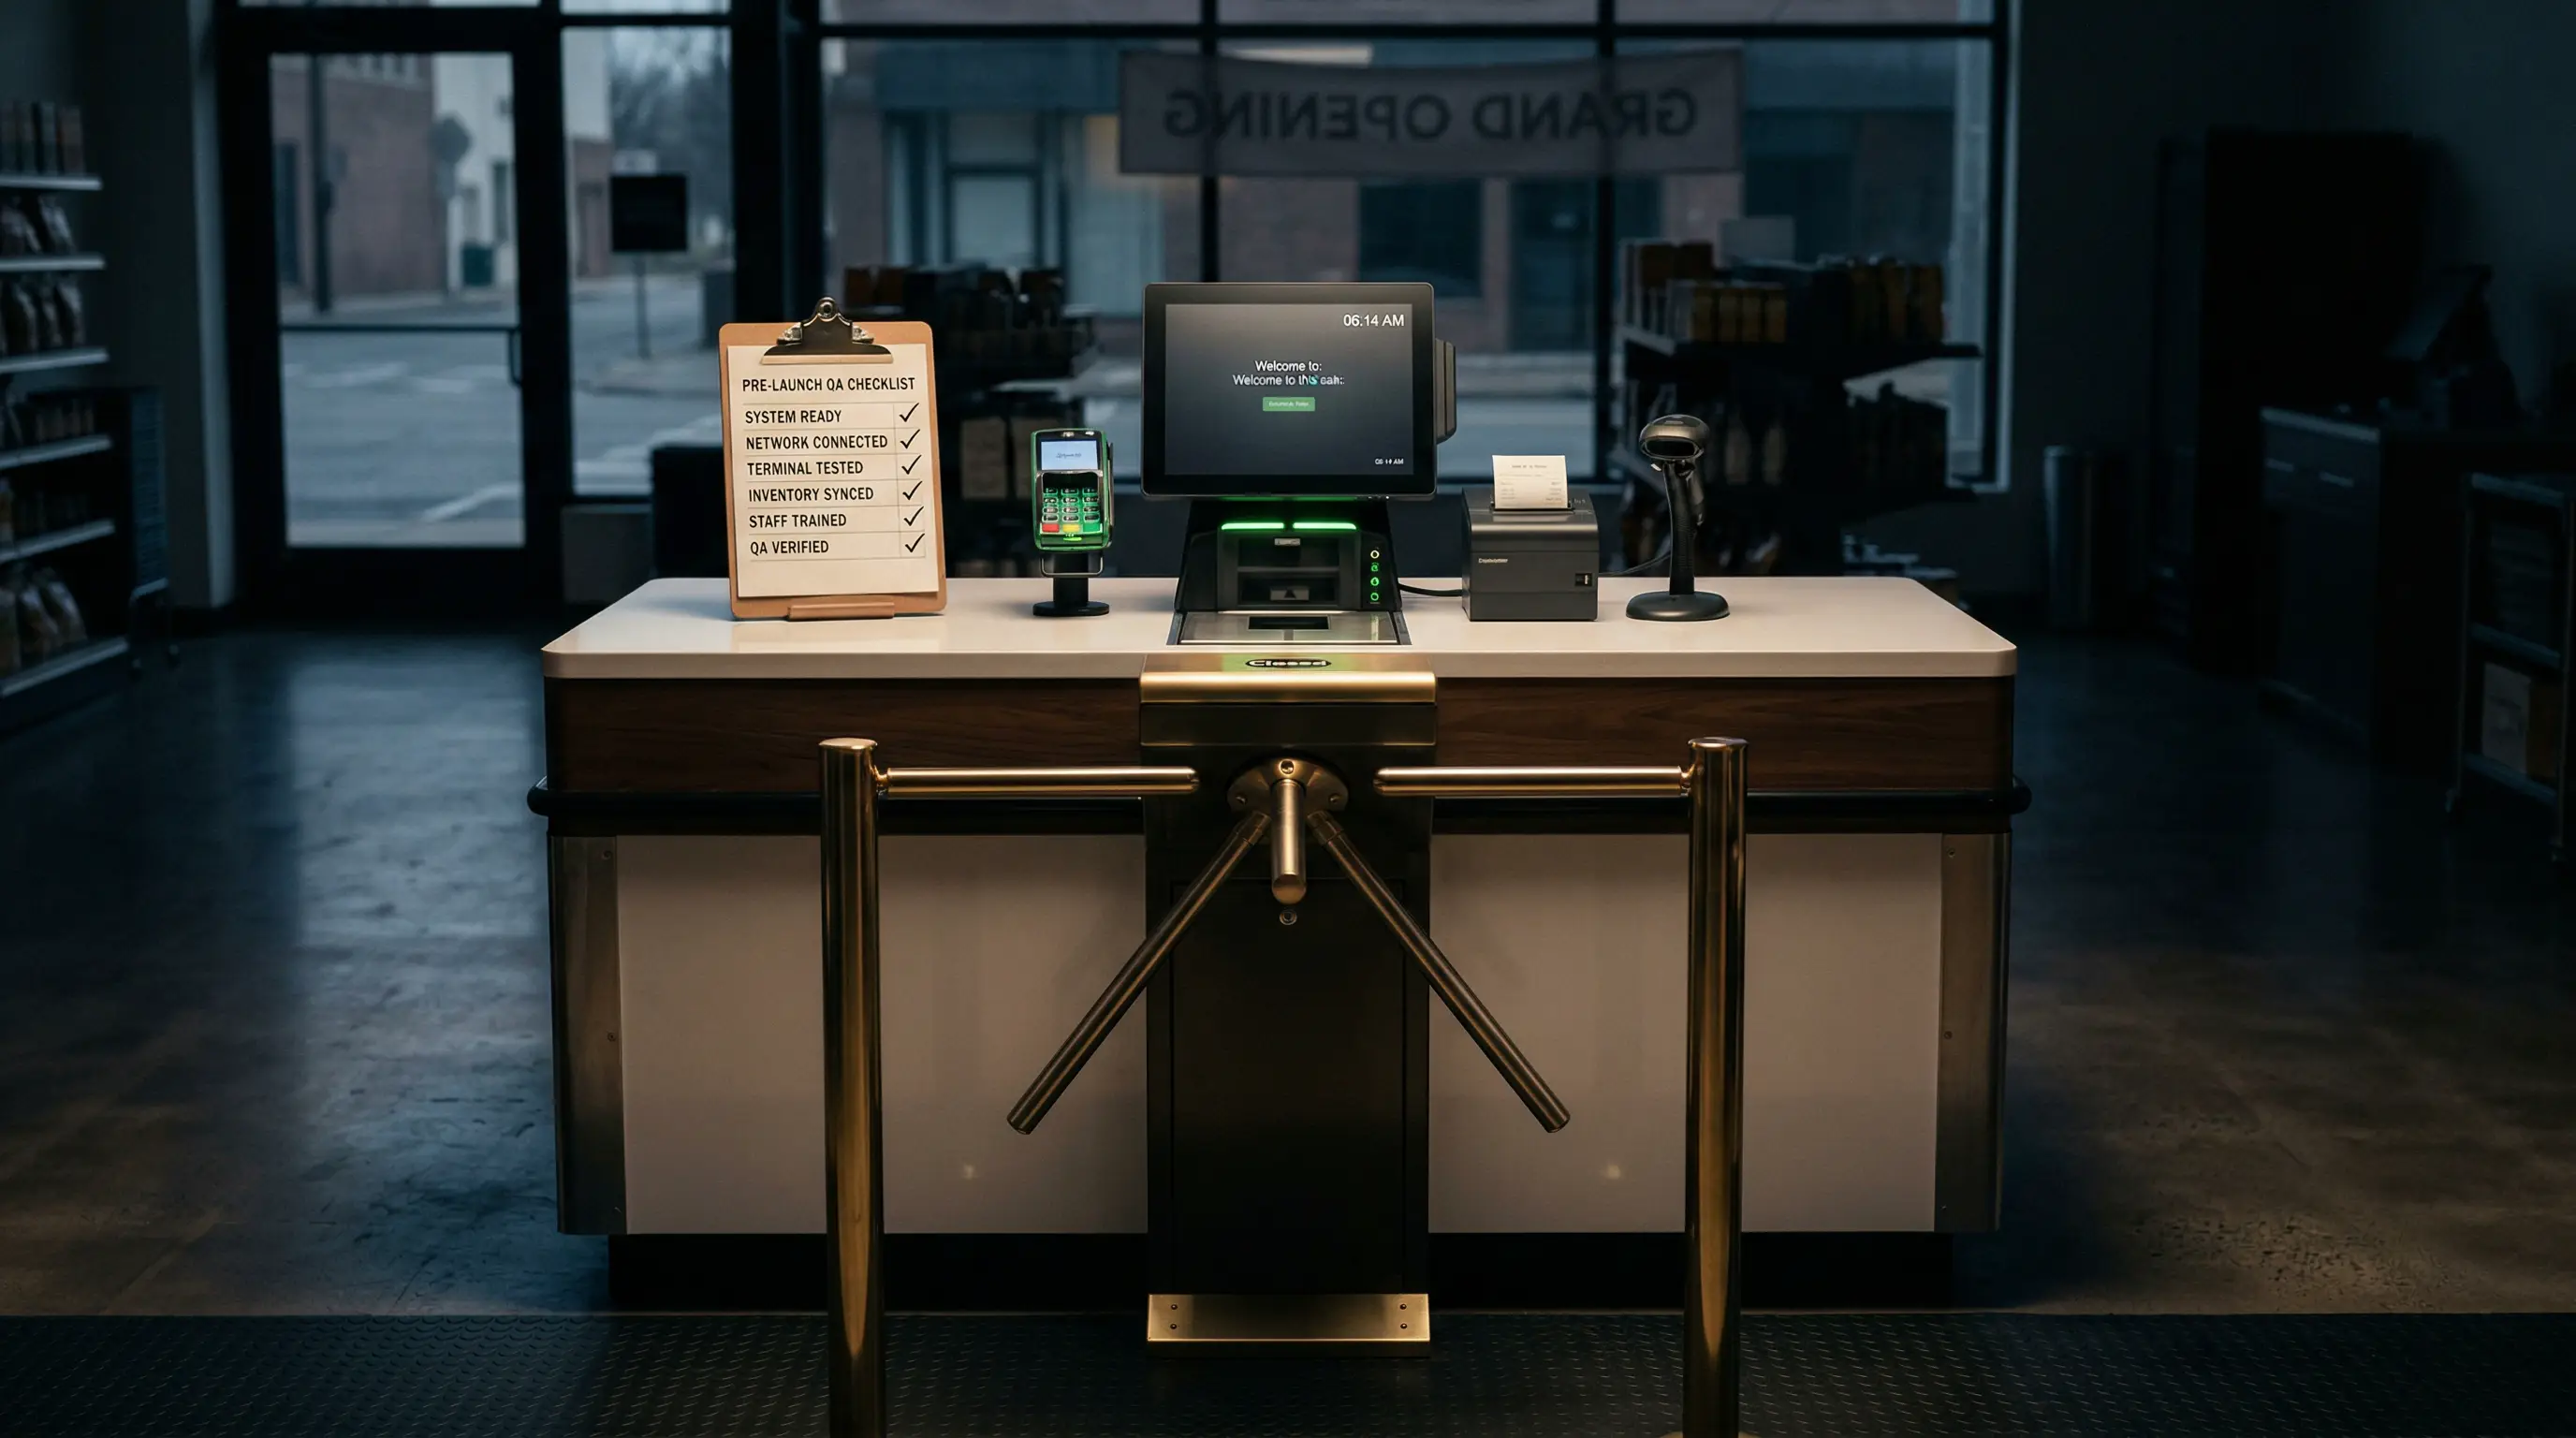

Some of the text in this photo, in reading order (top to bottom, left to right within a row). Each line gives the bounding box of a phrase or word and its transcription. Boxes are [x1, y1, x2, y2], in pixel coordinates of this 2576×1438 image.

[1382, 314, 1404, 327] AM
[1254, 360, 1323, 372] Welcome to:
[742, 377, 915, 391] PRE-LAUNCH QA CHECKLIST
[1232, 374, 1282, 386] Welcome
[1285, 374, 1296, 386] to
[745, 410, 842, 423] SYSTEM READY
[746, 435, 888, 450] NETWORK CONNECTED
[747, 461, 864, 476] TERMINAL TESTED
[749, 487, 874, 502] INVENTORY SYNCED
[749, 514, 847, 528] STAFF TRAINED
[750, 540, 829, 555] QA VERIFIED
